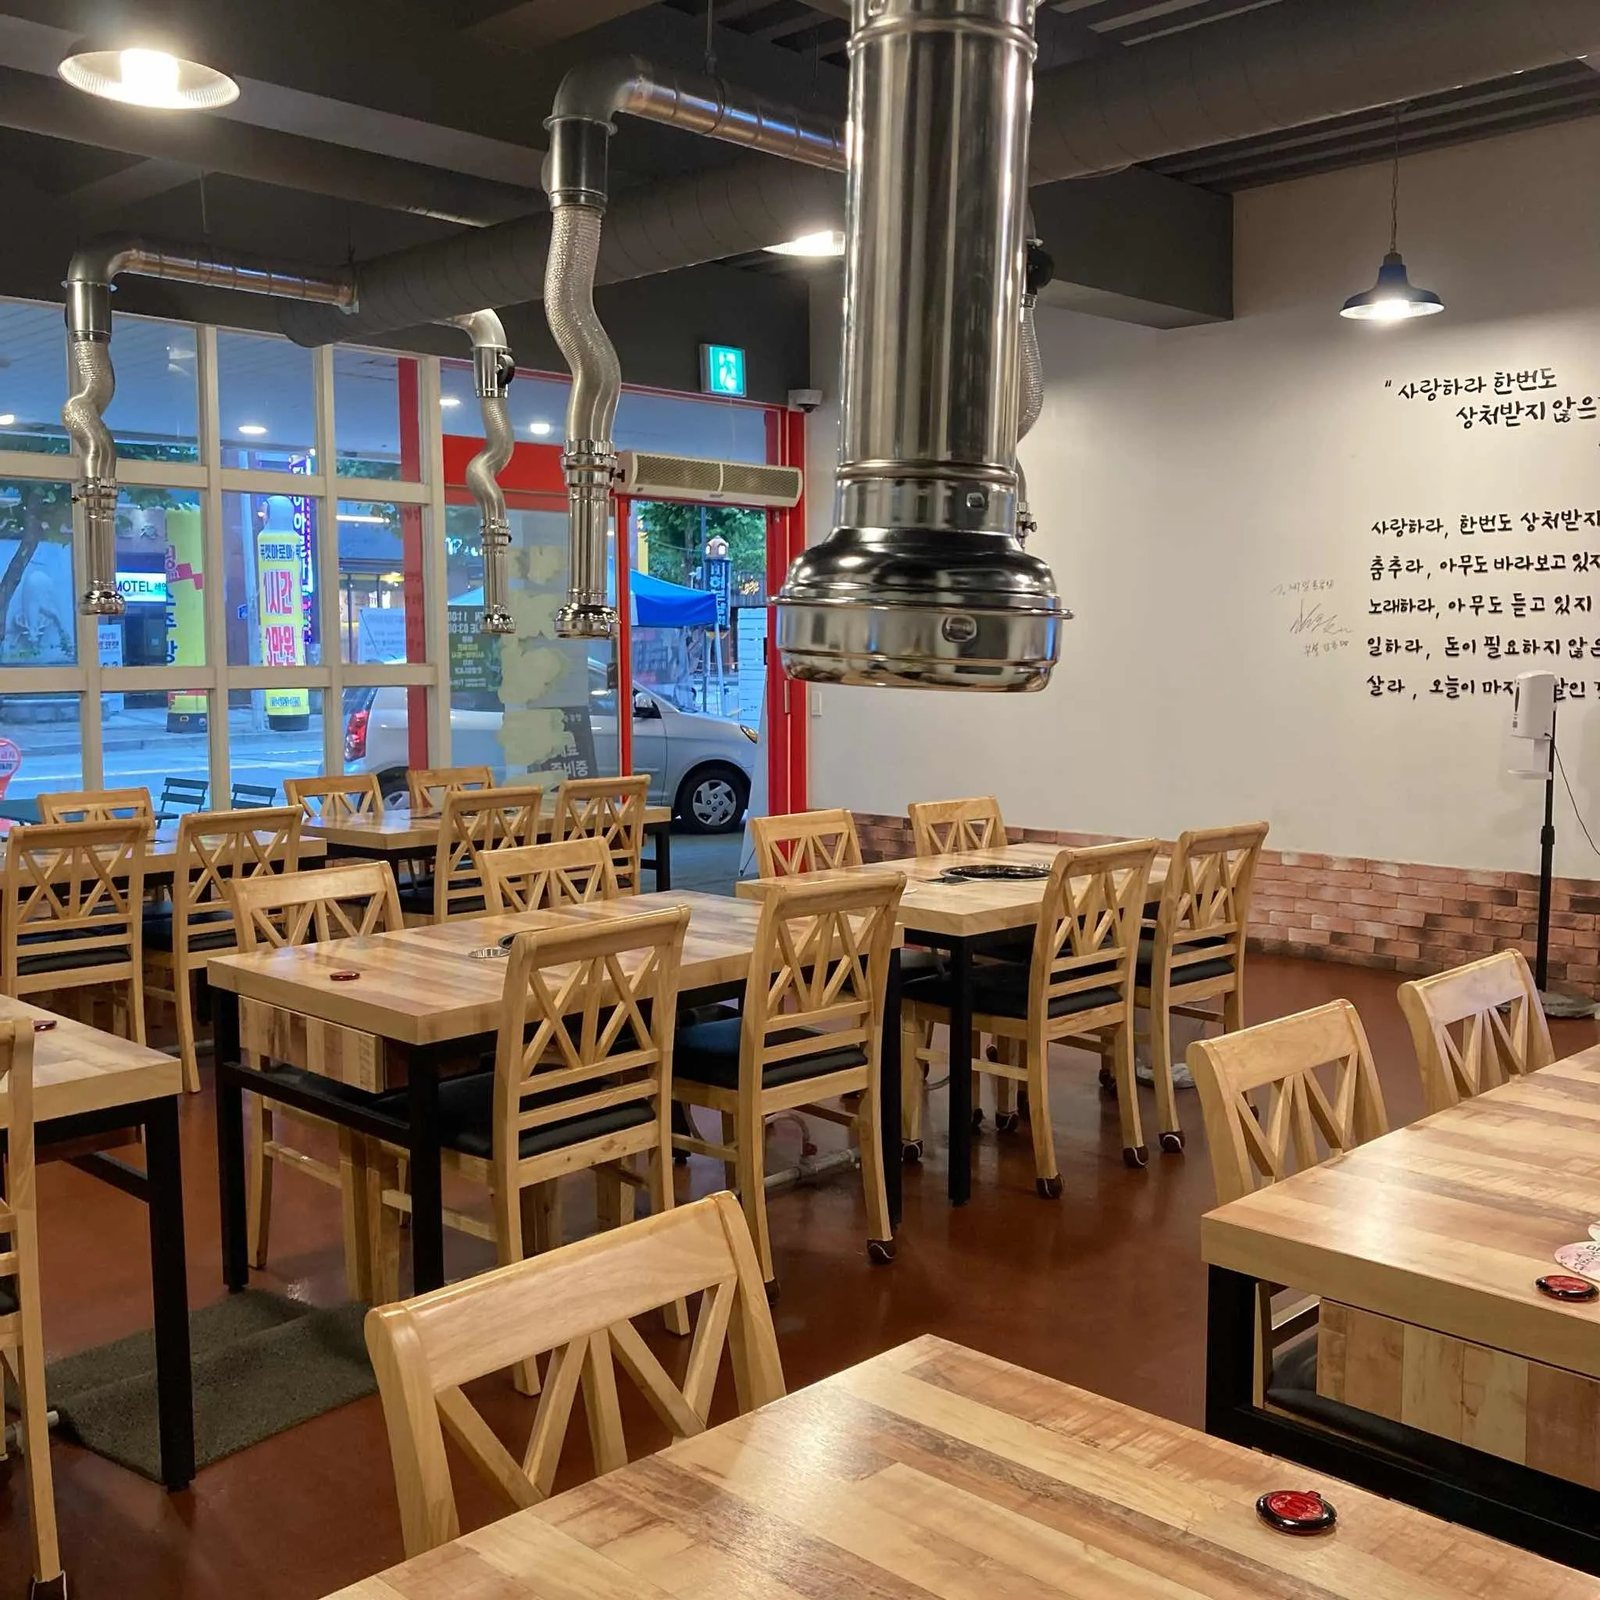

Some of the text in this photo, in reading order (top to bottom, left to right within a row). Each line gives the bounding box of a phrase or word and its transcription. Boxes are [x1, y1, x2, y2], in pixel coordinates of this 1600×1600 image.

[1493, 367, 1557, 395] 한번도
[1456, 401, 1545, 429] 상처받지
[1371, 517, 1448, 539] 사랑하라,
[1460, 513, 1513, 535] 한번도
[1370, 555, 1431, 581] 춤추라,
[1440, 555, 1488, 576] 아무도
[1494, 554, 1567, 572] 바라보고
[1368, 598, 1440, 619] 노래하라,
[1448, 595, 1503, 616] 아무도
[1511, 593, 1545, 618] 듣고
[1554, 594, 1592, 615] 있지
[1367, 635, 1431, 660] 일하라,
[1444, 636, 1477, 658] 돈이
[1484, 635, 1561, 659] 필요하지
[1429, 675, 1475, 699] 오늘이
